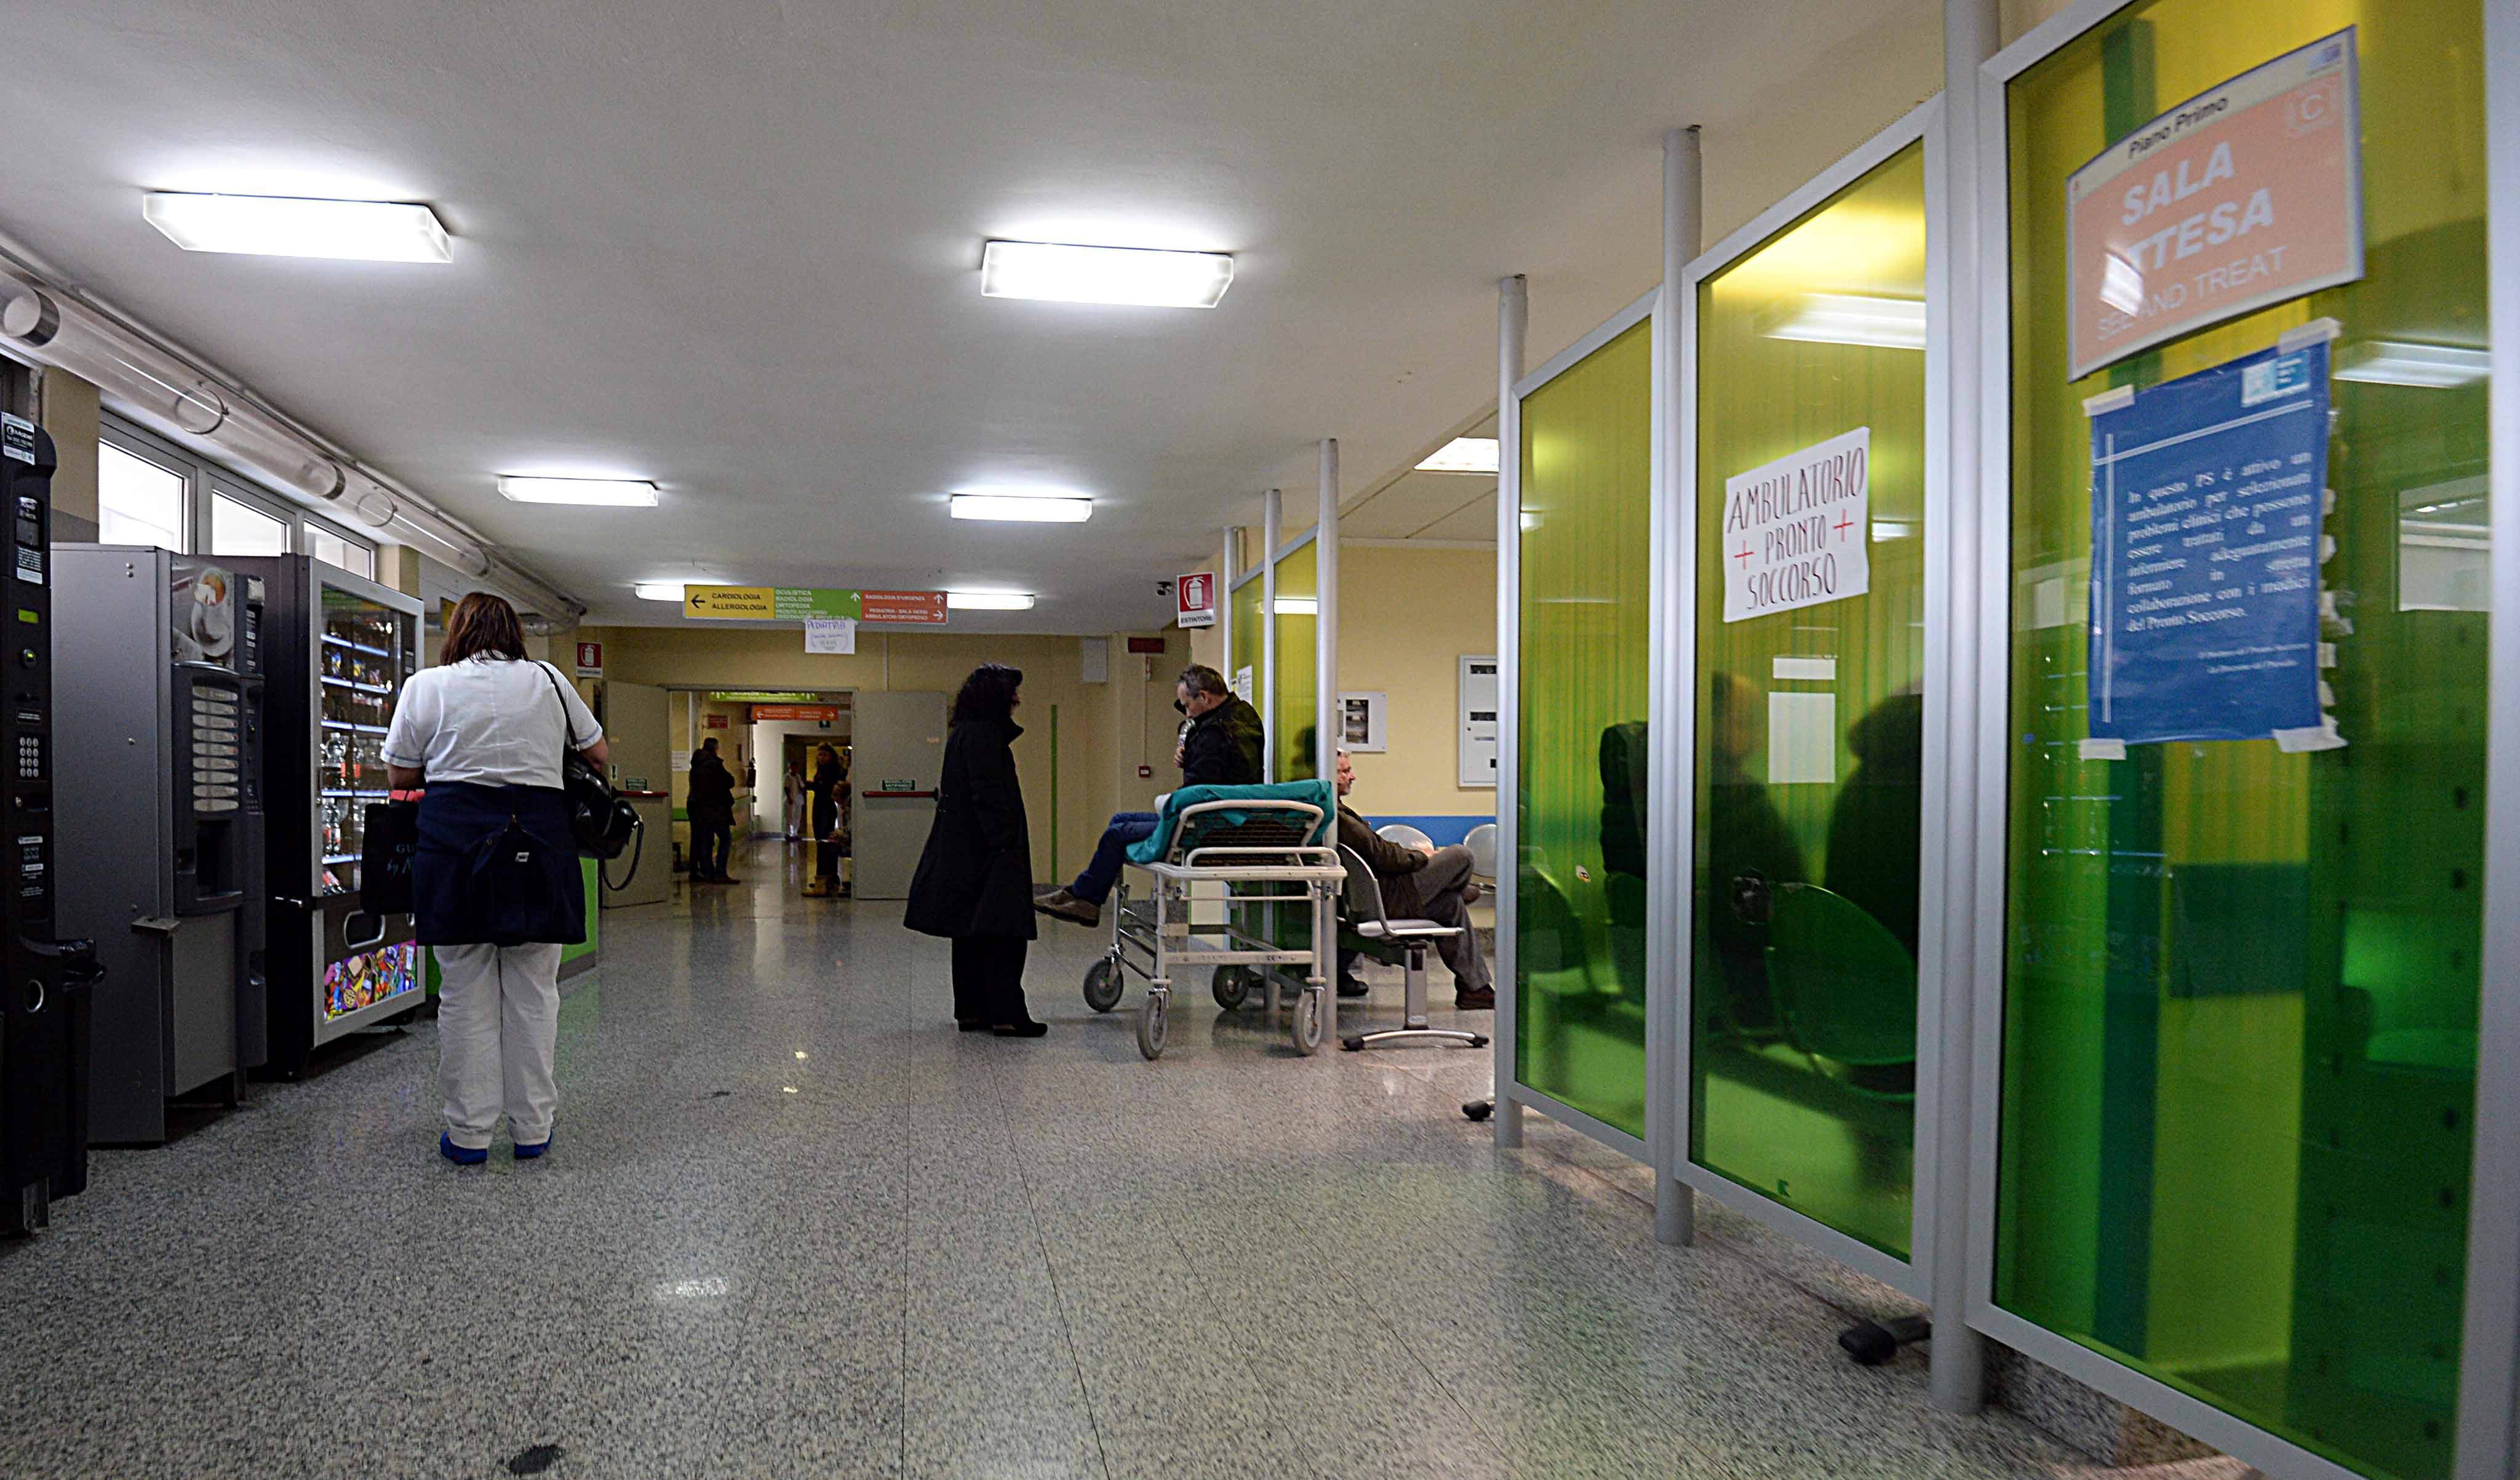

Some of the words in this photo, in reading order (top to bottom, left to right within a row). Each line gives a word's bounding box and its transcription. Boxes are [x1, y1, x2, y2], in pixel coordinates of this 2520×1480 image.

[2128, 127, 2171, 159] Piano
[2174, 97, 2230, 132] Primo
[2122, 140, 2235, 226] SALA
[2125, 187, 2275, 271] TTESA
[2196, 246, 2289, 298] TREAT
[1728, 447, 1865, 534] AMBULATORIO
[2127, 497, 2197, 522] ambulatorio
[2205, 492, 2227, 508] per
[2236, 470, 2311, 497] selezionati
[2128, 492, 2141, 503] In
[2147, 482, 2188, 502] questo
[2195, 472, 2215, 487] PS
[2241, 458, 2281, 476] attivo
[2289, 452, 2311, 464] un
[1765, 514, 1827, 565] PRONTO
[2127, 518, 2179, 543] problemi
[2181, 509, 2222, 529] clinici
[2224, 505, 2249, 520] che
[2252, 494, 2311, 518] possono
[2127, 544, 2163, 559] essere
[2182, 526, 2225, 547] trattati
[2246, 521, 2265, 535] da
[2290, 515, 2311, 527] un
[2127, 557, 2187, 577] infermiere
[2210, 535, 2311, 562] adeguatamente
[2127, 580, 2173, 596] formato
[2210, 568, 2225, 581] in
[2265, 556, 2311, 572] stretta
[712, 592, 762, 601] CARDIOLOGIA
[1747, 553, 1837, 610] SOCCORSO
[2126, 592, 2212, 614] collaborazione
[2215, 587, 2243, 601] con
[2247, 582, 2255, 596] i
[2260, 572, 2311, 593] medici
[712, 603, 768, 611] ALLERGOLOGIA
[1181, 615, 1213, 623] ESTINTORE
[2126, 616, 2146, 633] del
[2146, 615, 2186, 630] Pronto
[2186, 607, 2248, 624] Soccorso.
